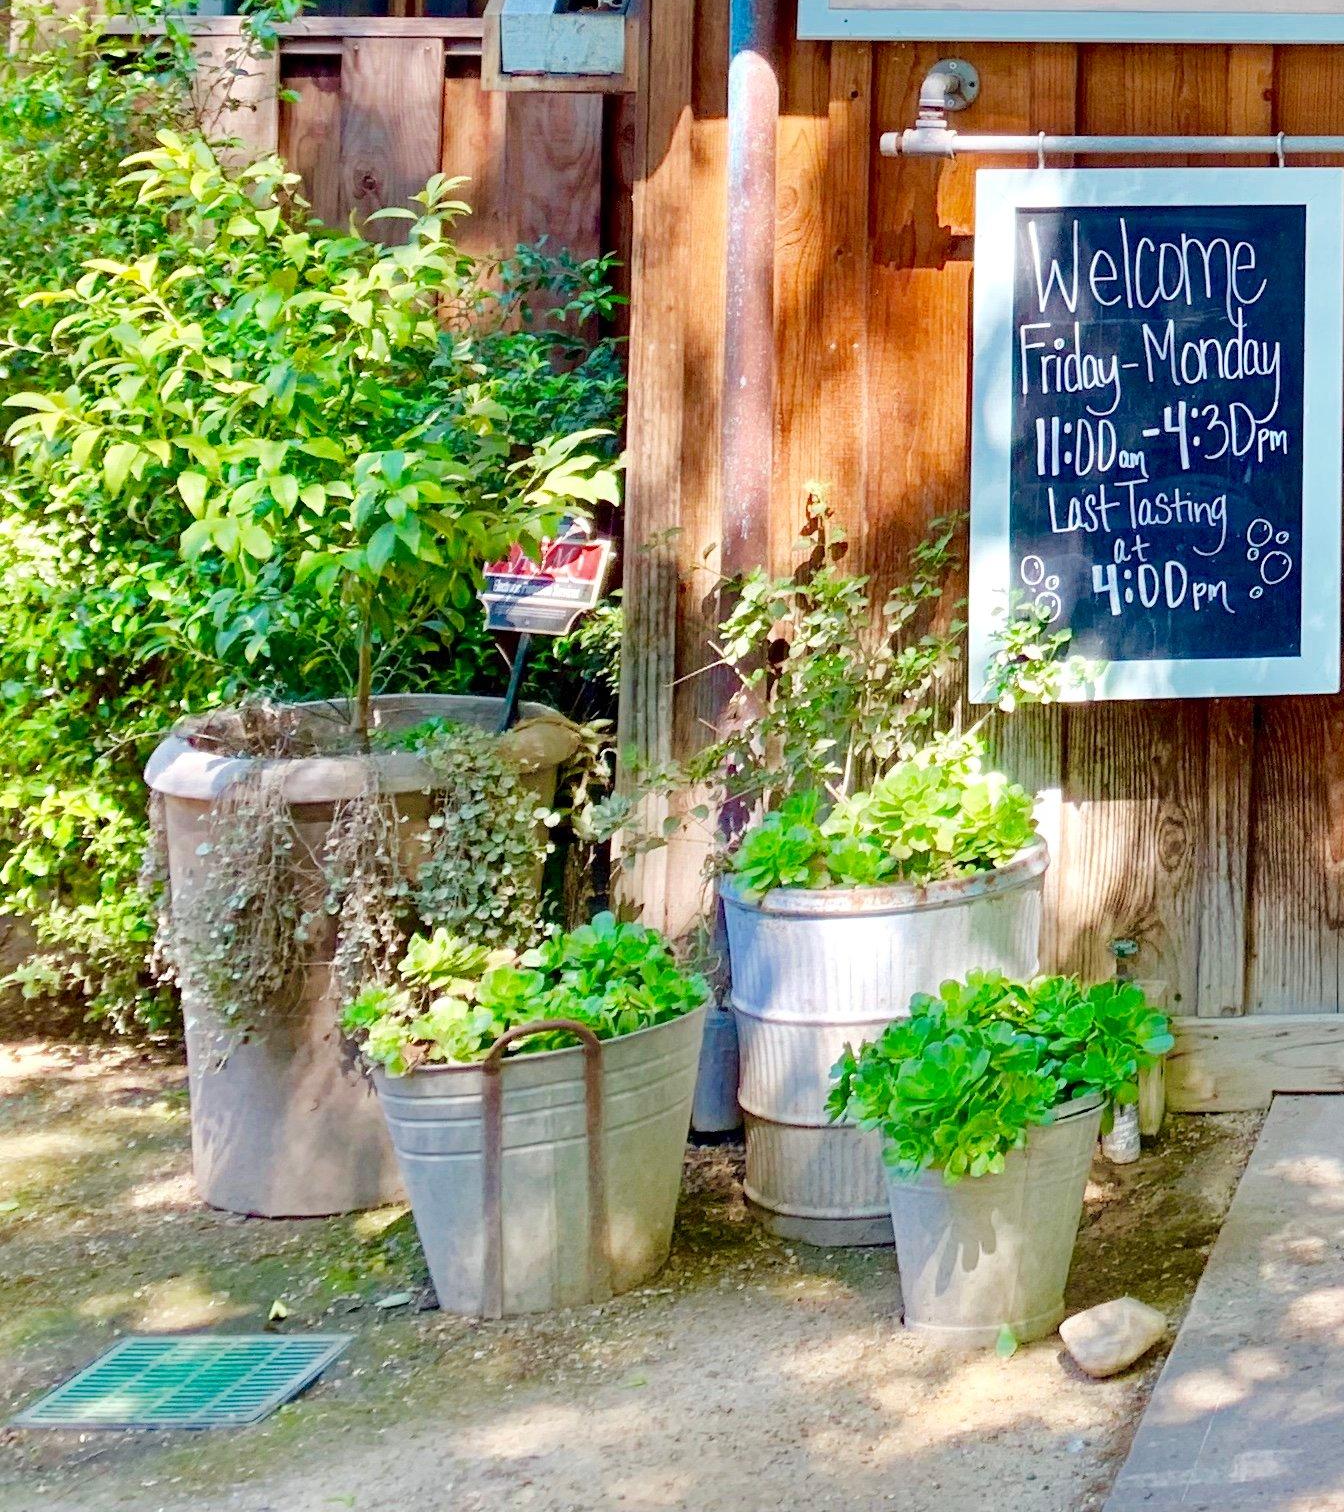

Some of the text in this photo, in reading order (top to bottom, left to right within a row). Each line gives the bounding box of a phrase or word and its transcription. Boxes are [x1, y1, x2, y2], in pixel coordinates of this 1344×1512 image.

[1028, 217, 1267, 328] Welcome
[1047, 479, 1228, 556] Last Tasting
[1114, 535, 1150, 563] at
